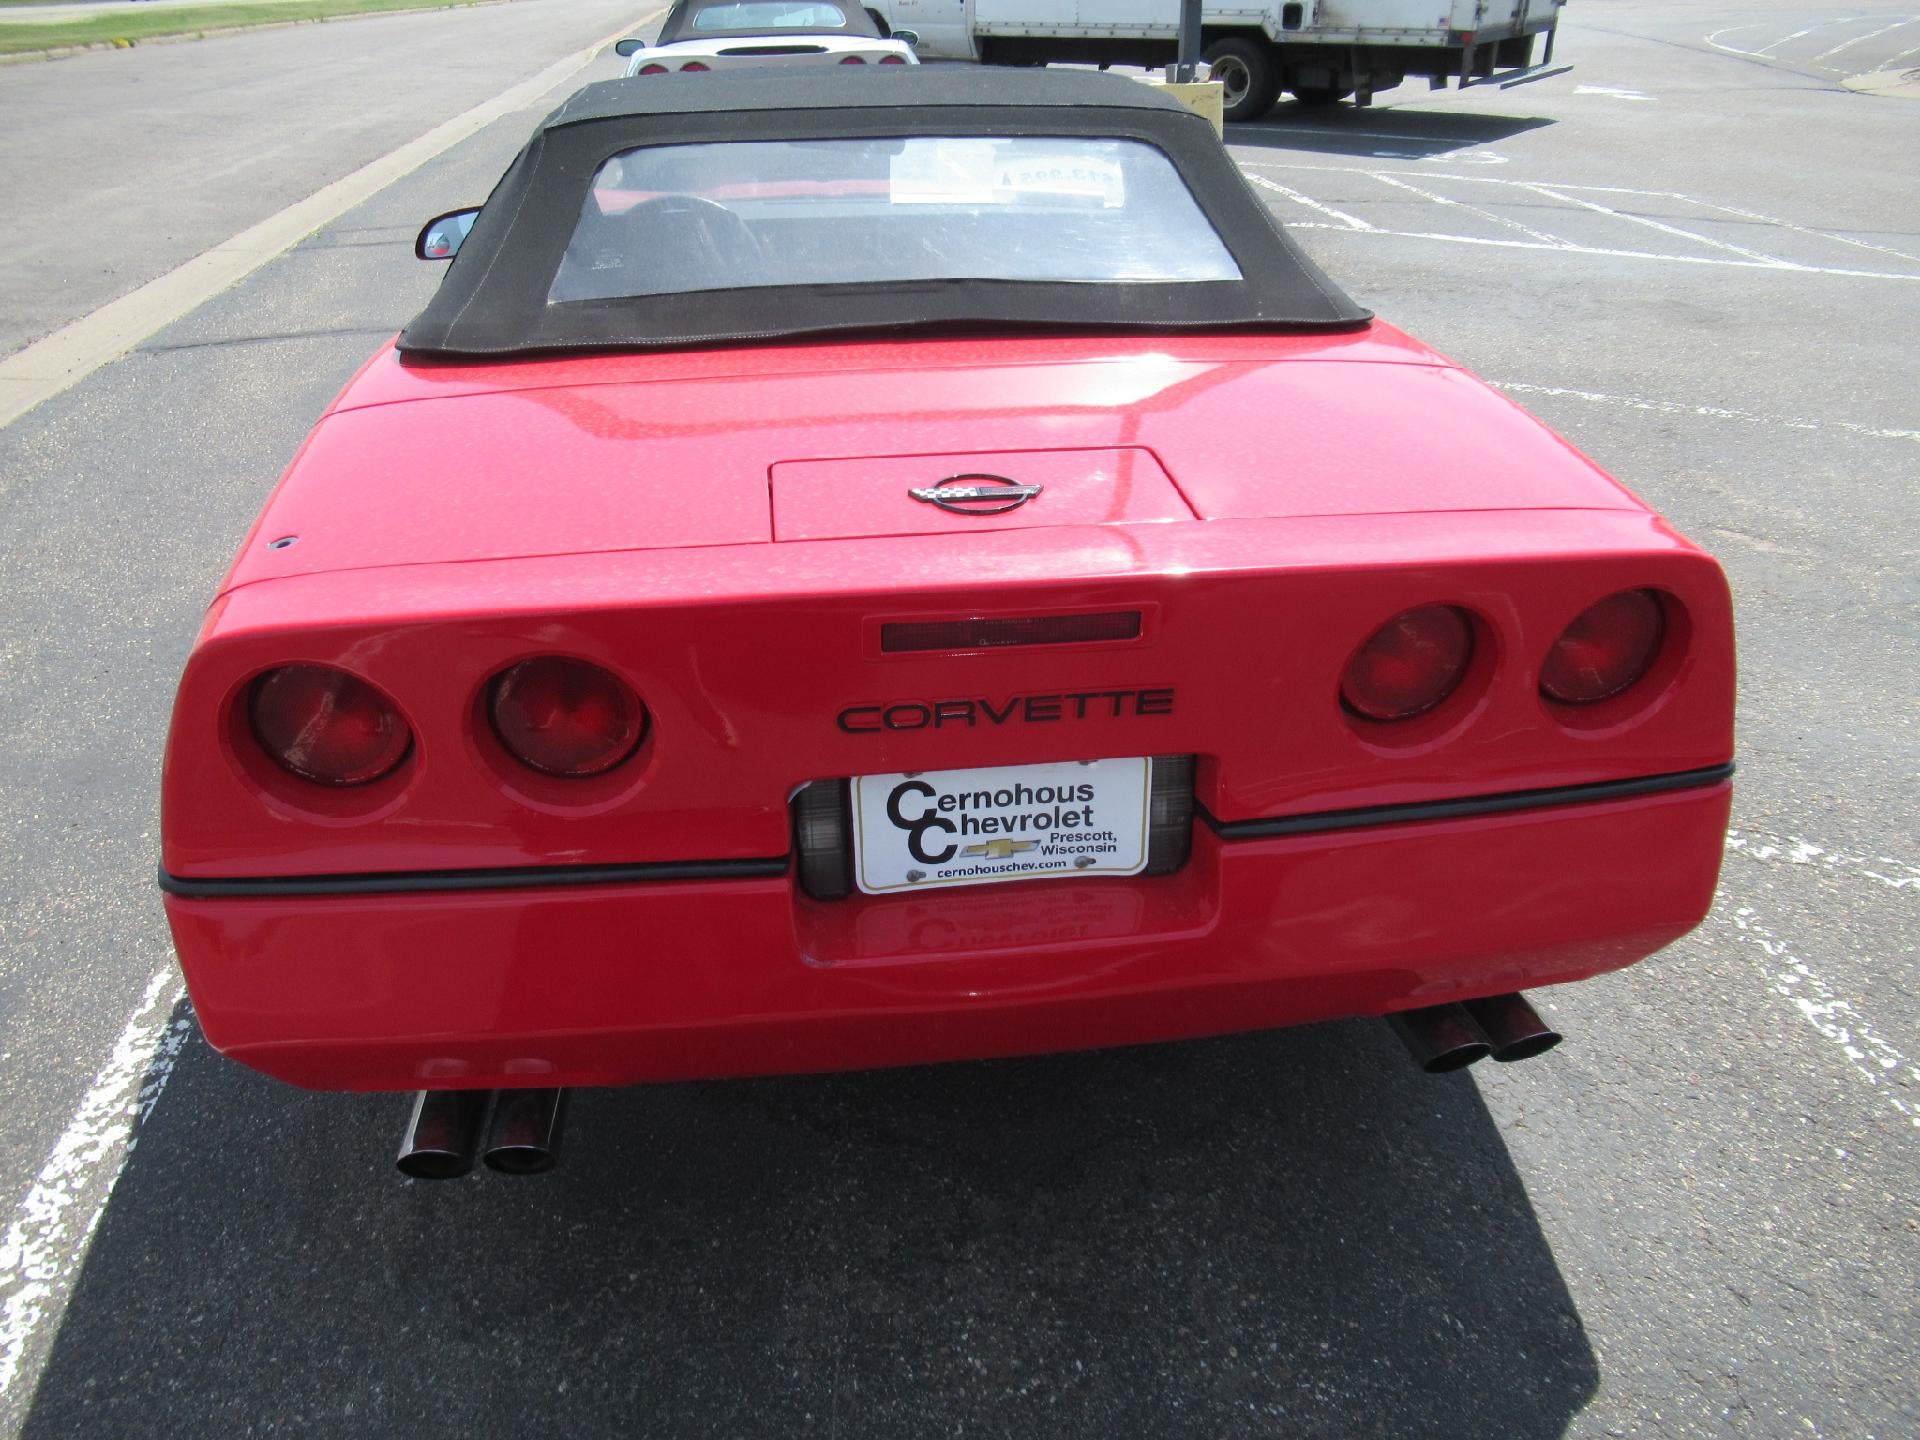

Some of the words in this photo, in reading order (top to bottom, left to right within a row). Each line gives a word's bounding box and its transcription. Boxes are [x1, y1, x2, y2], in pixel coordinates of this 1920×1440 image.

[837, 688, 1174, 733] CORVETTE
[887, 781, 1094, 829] Cernohous
[908, 805, 1094, 864] Chevrolet
[1041, 843, 1116, 855] Wisconsin
[1050, 831, 1117, 843] Prescott,
[937, 860, 1067, 878] cernohouschev.com
